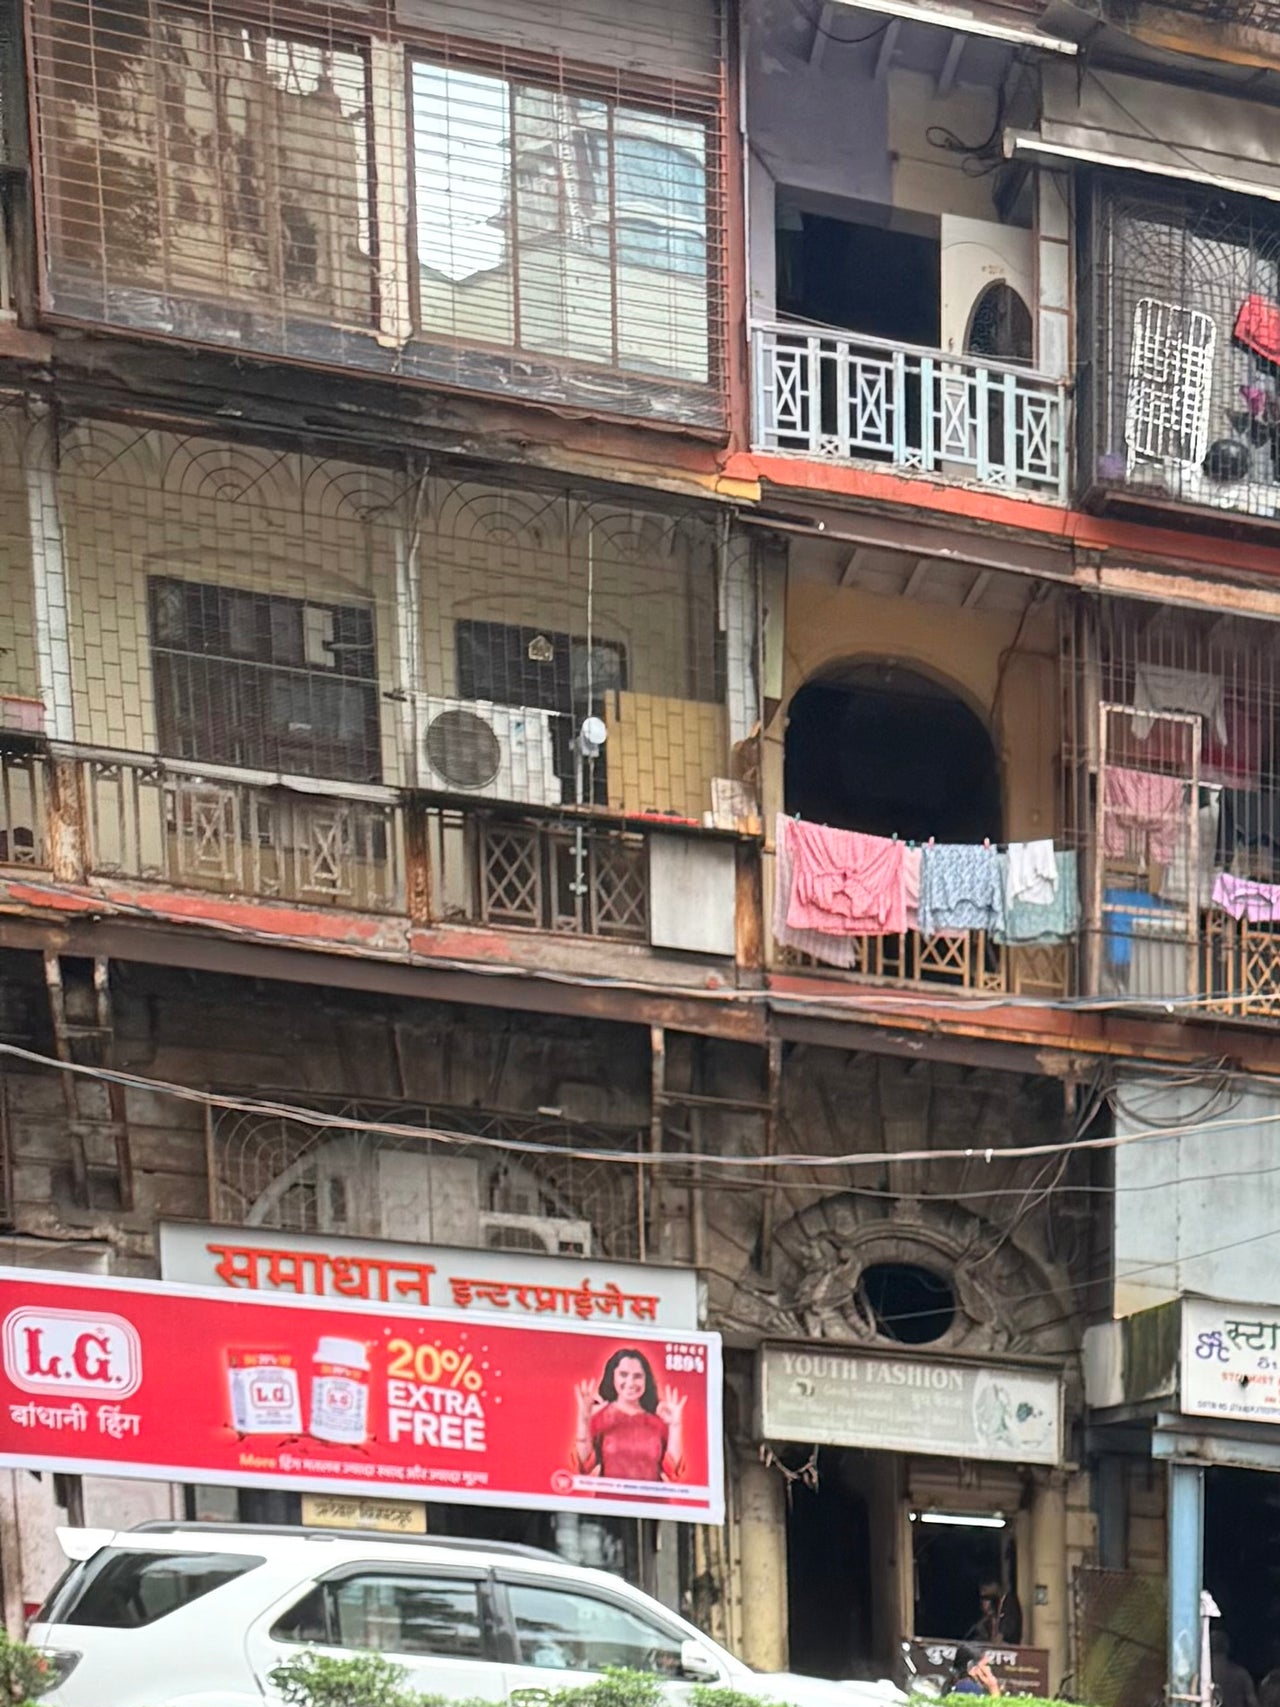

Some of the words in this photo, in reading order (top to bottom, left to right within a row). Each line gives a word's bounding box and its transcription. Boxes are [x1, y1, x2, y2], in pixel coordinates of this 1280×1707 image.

[206, 1243, 436, 1305] समाधान
[387, 1338, 482, 1392] 20%
[782, 1354, 858, 1380] YOUTH
[865, 1361, 964, 1391] FASHION
[1222, 1371, 1273, 1385] STOKIST
[387, 1379, 485, 1418] EXTRA
[388, 1408, 486, 1452] FREE
